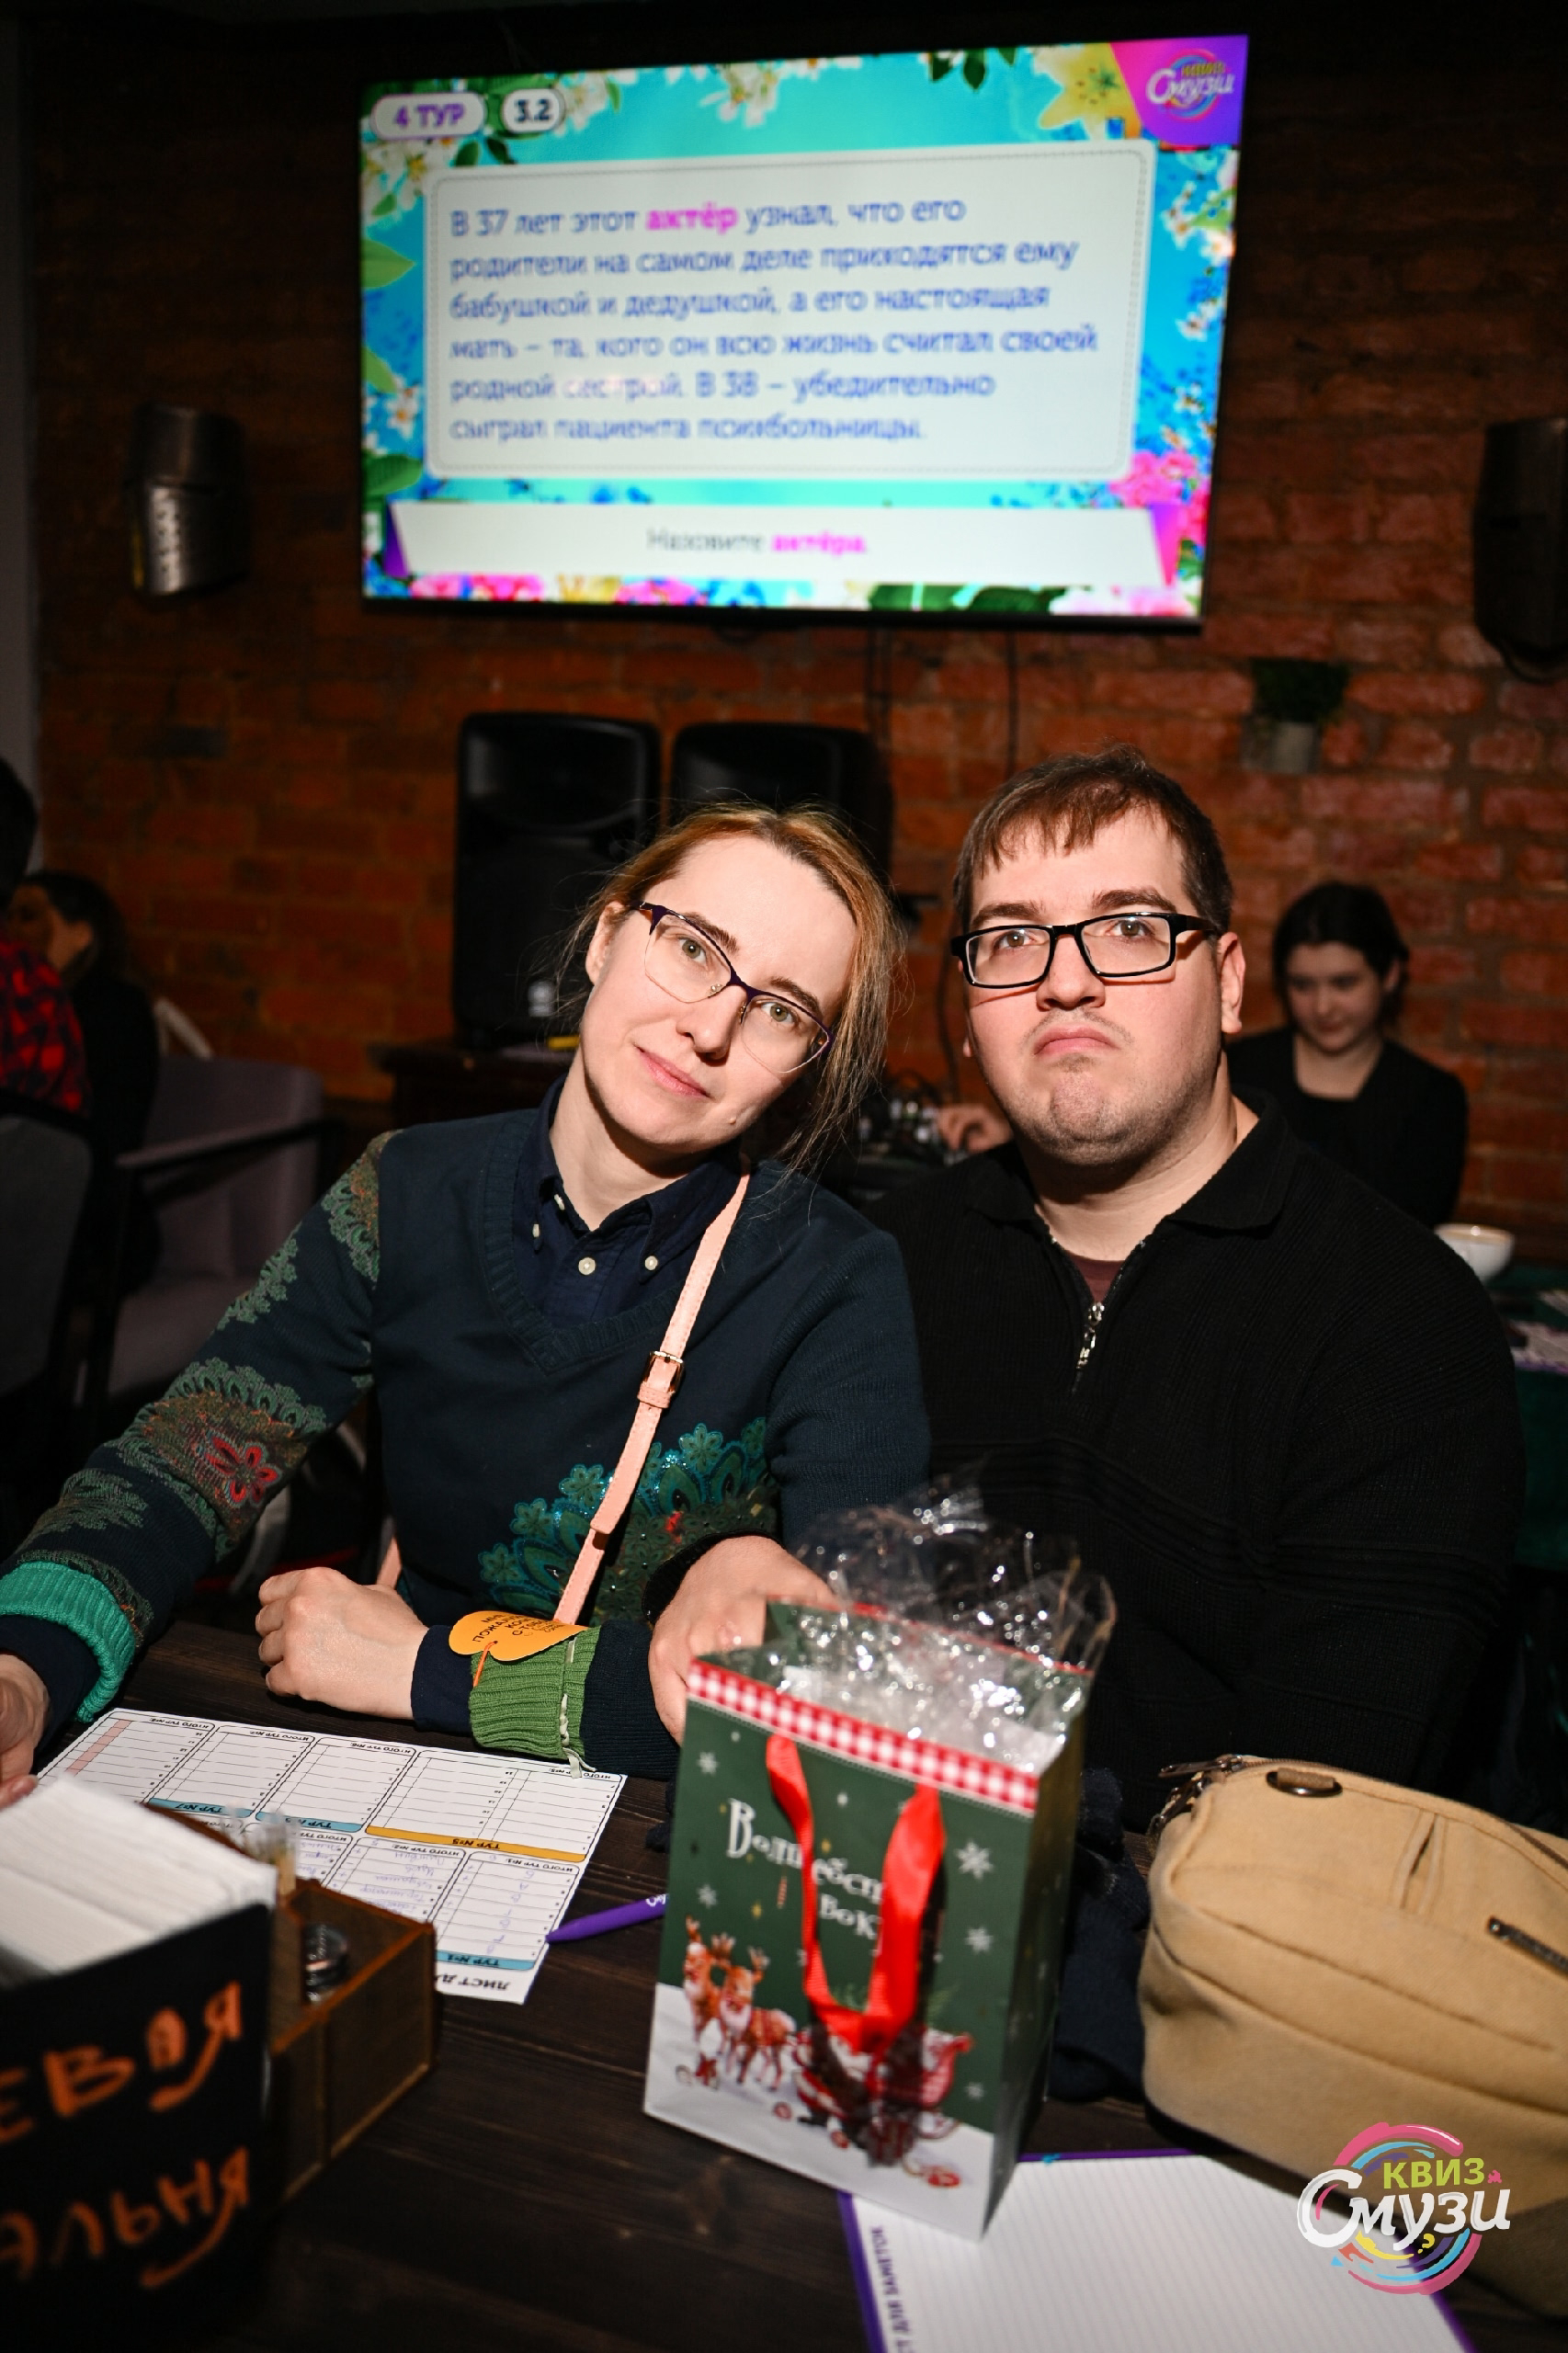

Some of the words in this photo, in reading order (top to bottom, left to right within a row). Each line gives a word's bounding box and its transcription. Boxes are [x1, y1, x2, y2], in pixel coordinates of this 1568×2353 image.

[393, 106, 410, 127] 4
[416, 103, 465, 127] ТУР
[514, 98, 553, 122] 3.2
[449, 210, 469, 237] В
[475, 209, 509, 237] 37
[514, 212, 564, 234] лет
[570, 210, 639, 233] этот
[645, 201, 739, 234] актёр
[745, 203, 839, 234] узнал,
[846, 201, 905, 223] что
[910, 199, 968, 222] его
[449, 256, 587, 283] родители
[594, 254, 631, 273] на
[635, 251, 734, 273] самом
[739, 248, 812, 274] деле
[820, 243, 1008, 274] приходятся
[1013, 241, 1079, 271] ему
[449, 290, 592, 324] бабушкой
[597, 296, 618, 315] и
[621, 287, 780, 322] дедушкой,
[789, 290, 809, 313] а
[813, 289, 869, 313] его
[874, 286, 1051, 313] настоящая
[449, 338, 517, 359] мать
[597, 335, 665, 358] кого
[668, 335, 709, 358] он
[715, 335, 777, 358] всю
[782, 333, 878, 356] жизнь
[882, 331, 994, 355] считал
[999, 324, 1098, 355] своей
[449, 374, 556, 404] родной
[695, 370, 715, 398] В
[722, 369, 759, 398] 38
[791, 369, 997, 404] убедительно
[449, 418, 548, 445] сыграл
[553, 418, 690, 442] пациента
[199, 1805, 223, 1813] ТУР
[308, 1821, 332, 1829] ТУР
[476, 1842, 500, 1850] ТУР
[819, 1893, 883, 1940] Вок
[473, 1959, 499, 1967] ТУР
[458, 1976, 511, 1991] ЛИСТ
